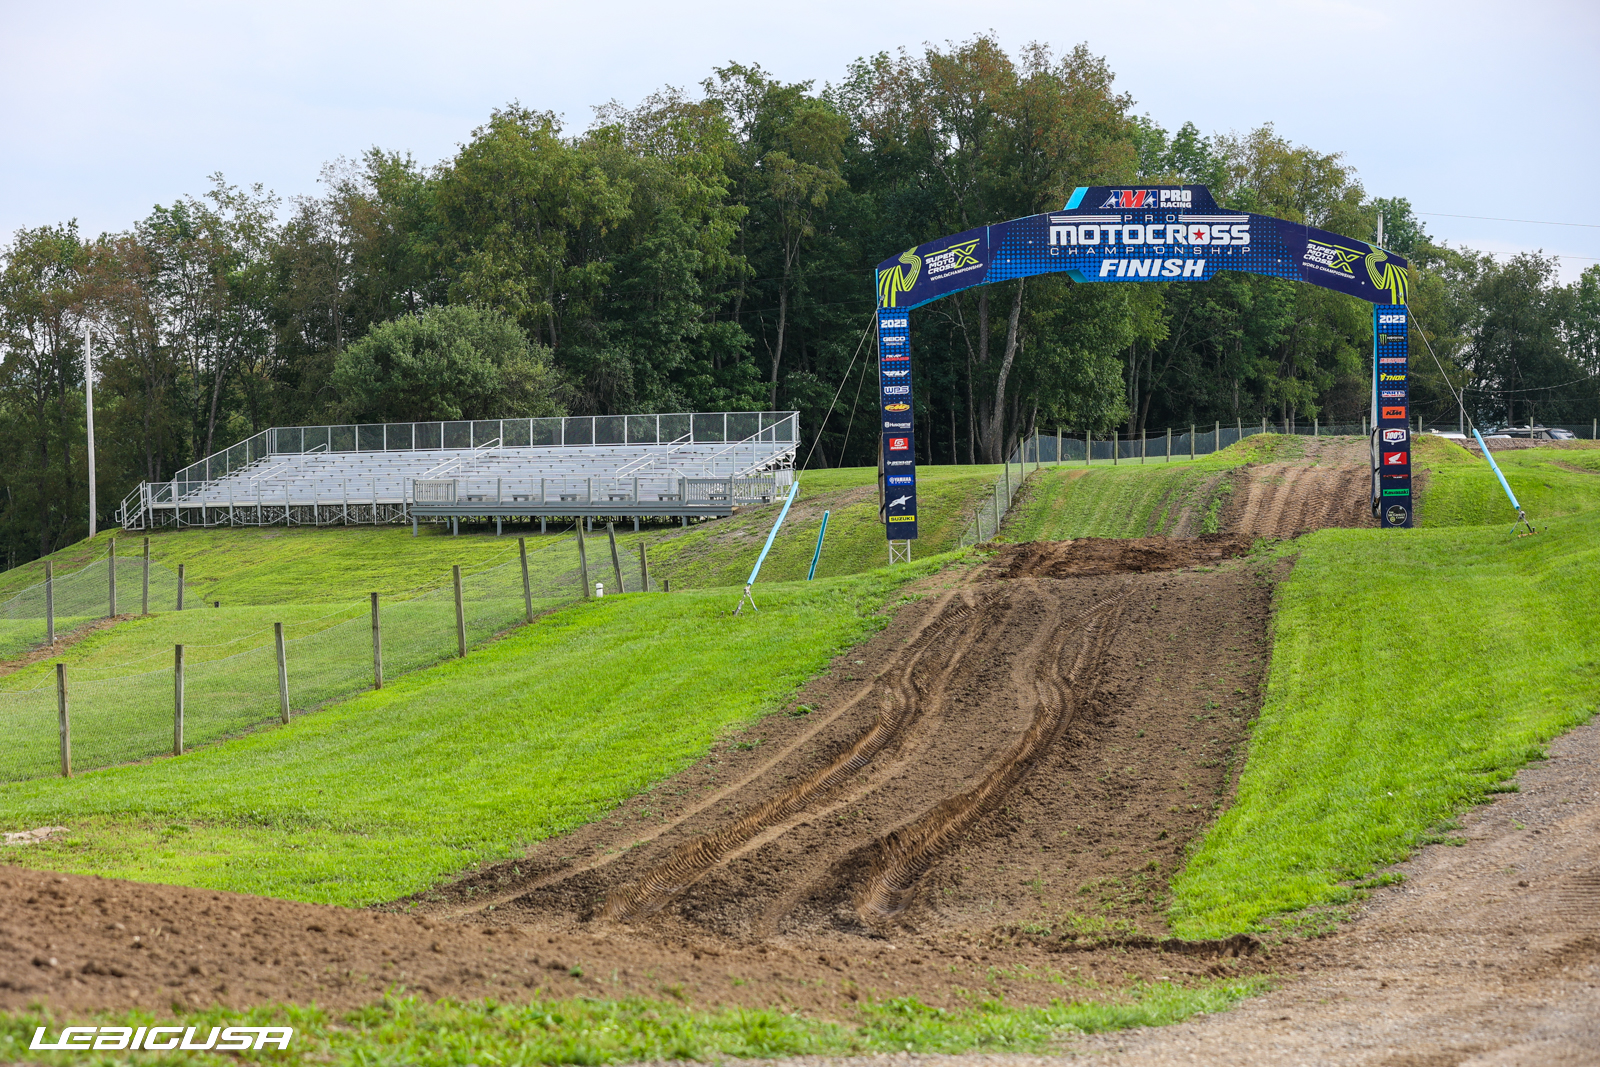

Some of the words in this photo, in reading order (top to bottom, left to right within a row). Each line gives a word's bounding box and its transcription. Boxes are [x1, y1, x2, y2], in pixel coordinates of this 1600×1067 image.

[1099, 189, 1158, 208] AMA
[1160, 189, 1192, 202] PRO
[1124, 214, 1176, 222] PRO
[1050, 224, 1250, 245] MOTOCROSS
[1050, 246, 1250, 256] CHAMPIONSHIP
[1306, 243, 1337, 256] SUPER
[1307, 249, 1334, 260] MOTO
[925, 251, 955, 264] SUPER
[928, 257, 955, 269] MOTO
[1303, 254, 1333, 266] CROSS
[928, 262, 956, 275] CROSS
[1099, 259, 1206, 277] FINISH
[1302, 262, 1319, 270] WORLD
[881, 319, 907, 328] 2023
[1379, 315, 1406, 323] 2023
[884, 386, 909, 394] WPS
[1386, 432, 1404, 440] 100%
